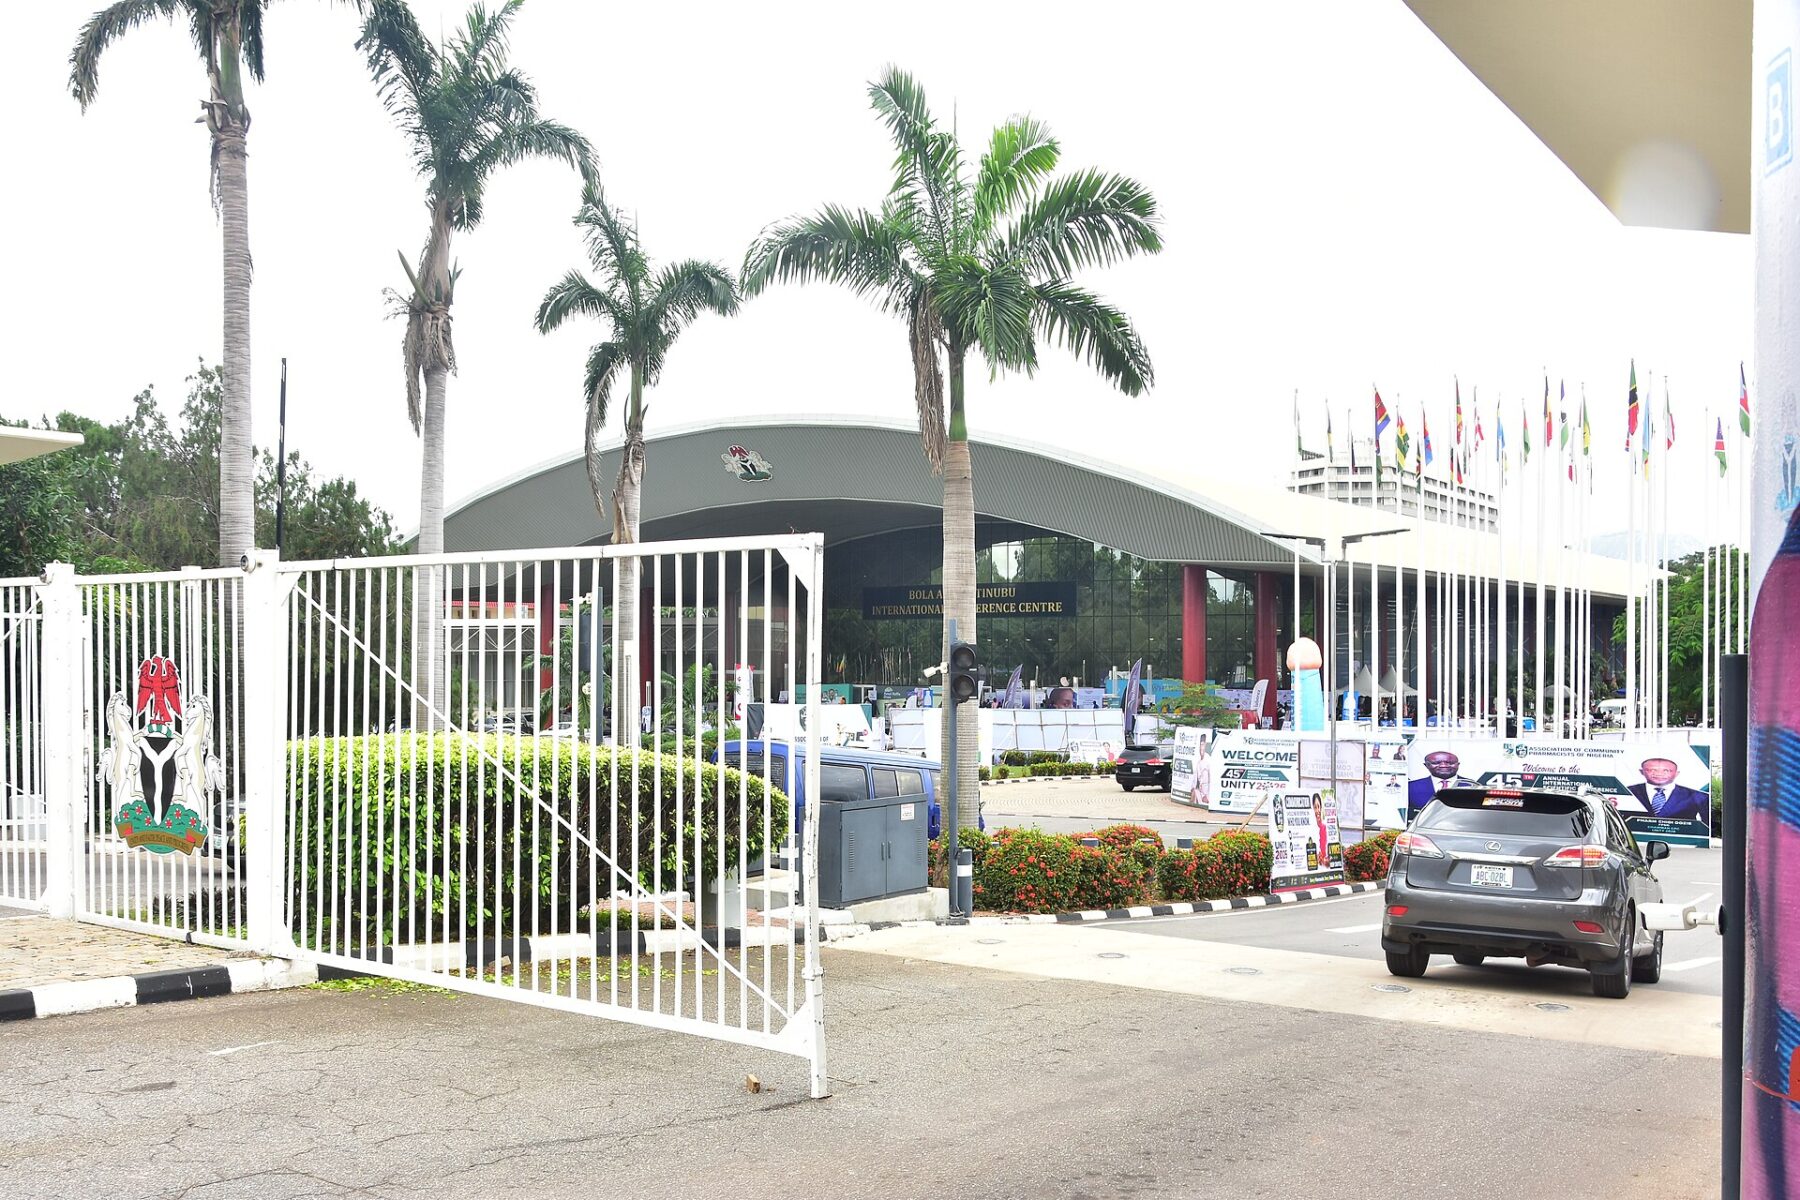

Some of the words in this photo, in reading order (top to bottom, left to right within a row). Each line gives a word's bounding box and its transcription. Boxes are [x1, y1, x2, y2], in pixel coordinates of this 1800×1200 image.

[909, 590, 934, 600] BOLA
[976, 588, 1016, 598] TINUBU
[976, 603, 1016, 613] ERENCE
[1019, 602, 1063, 613] CENTRE
[1222, 750, 1297, 762] WELCOME
[1225, 769, 1240, 779] 45
[1522, 763, 1556, 773] Welcome
[1558, 764, 1566, 774] to
[1568, 764, 1580, 774] the
[1221, 780, 1255, 790] UNITY
